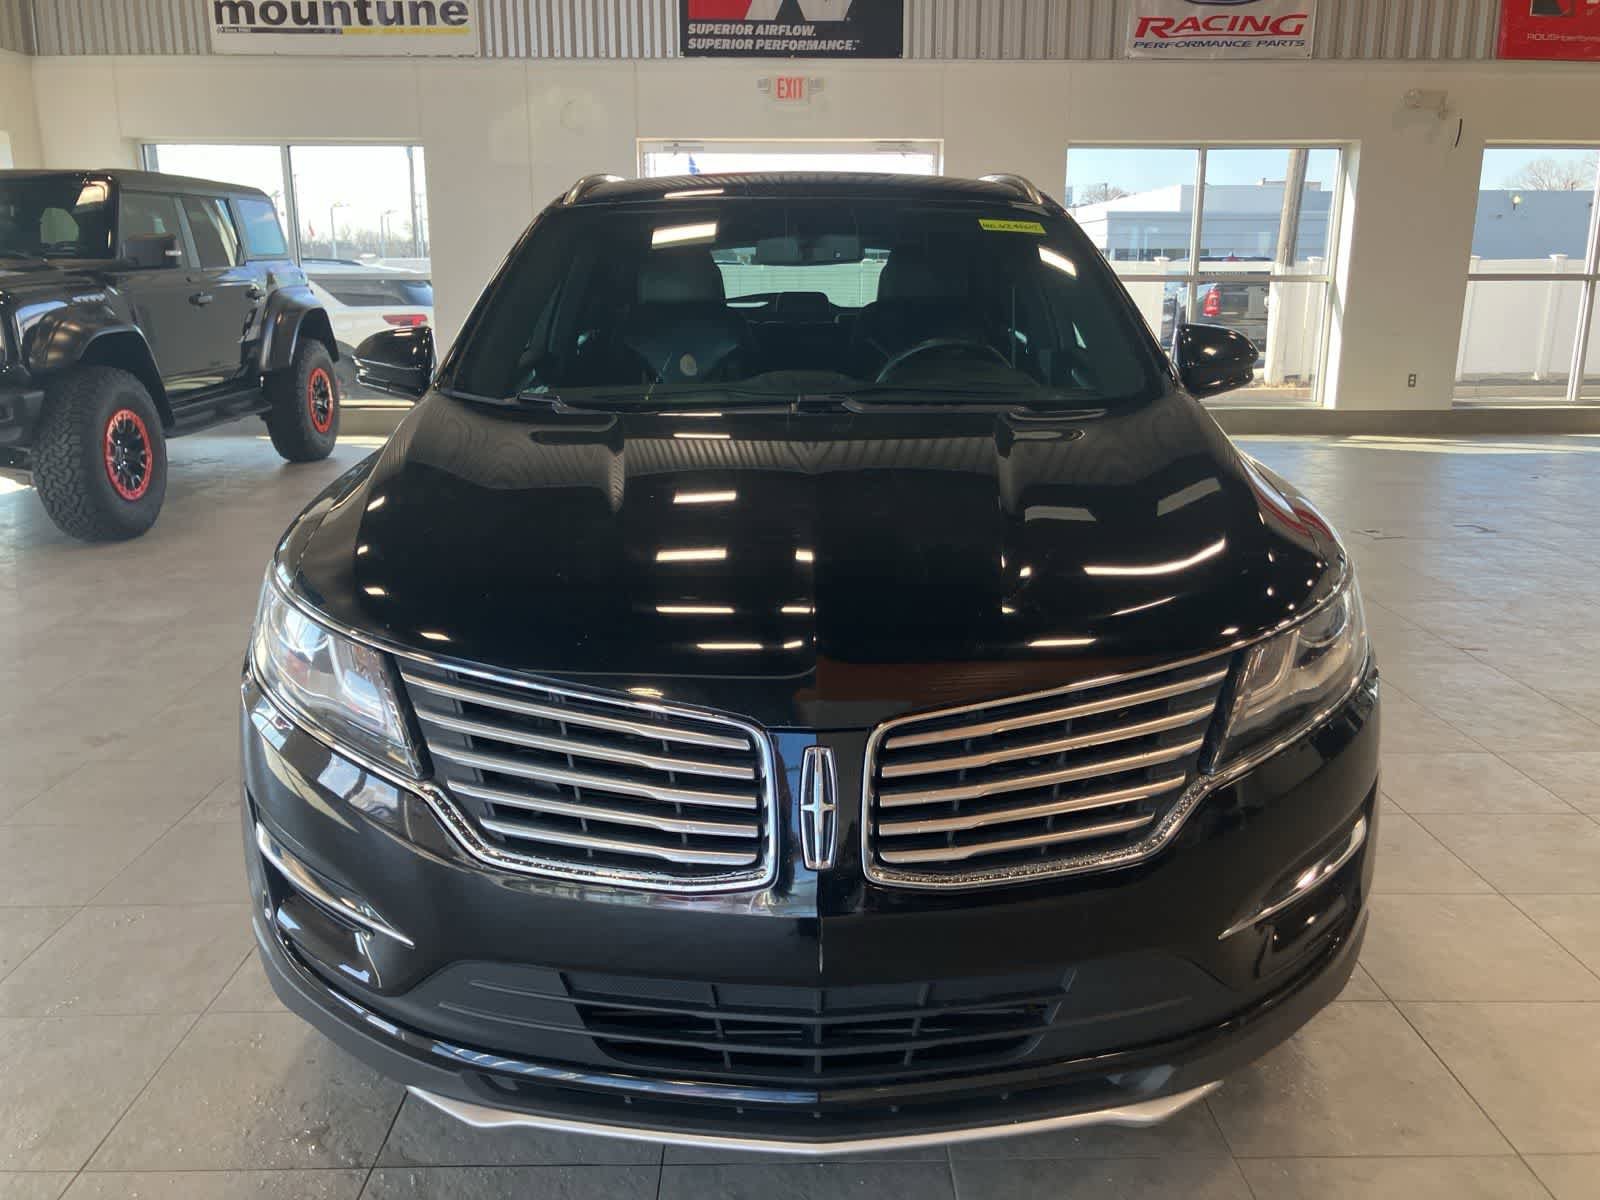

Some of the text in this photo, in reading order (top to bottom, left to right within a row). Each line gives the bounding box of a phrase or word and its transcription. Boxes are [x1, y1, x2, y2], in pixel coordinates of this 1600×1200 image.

[214, 0, 469, 26] mountune
[688, 24, 816, 36] SUPERIOR AIRFLOW.
[1134, 14, 1308, 38] RACING
[688, 38, 857, 50] SUPERIOR PERFORMANCE.
[1133, 40, 1305, 49] PERFORMANCE PARTS
[776, 76, 806, 99] EXIT
